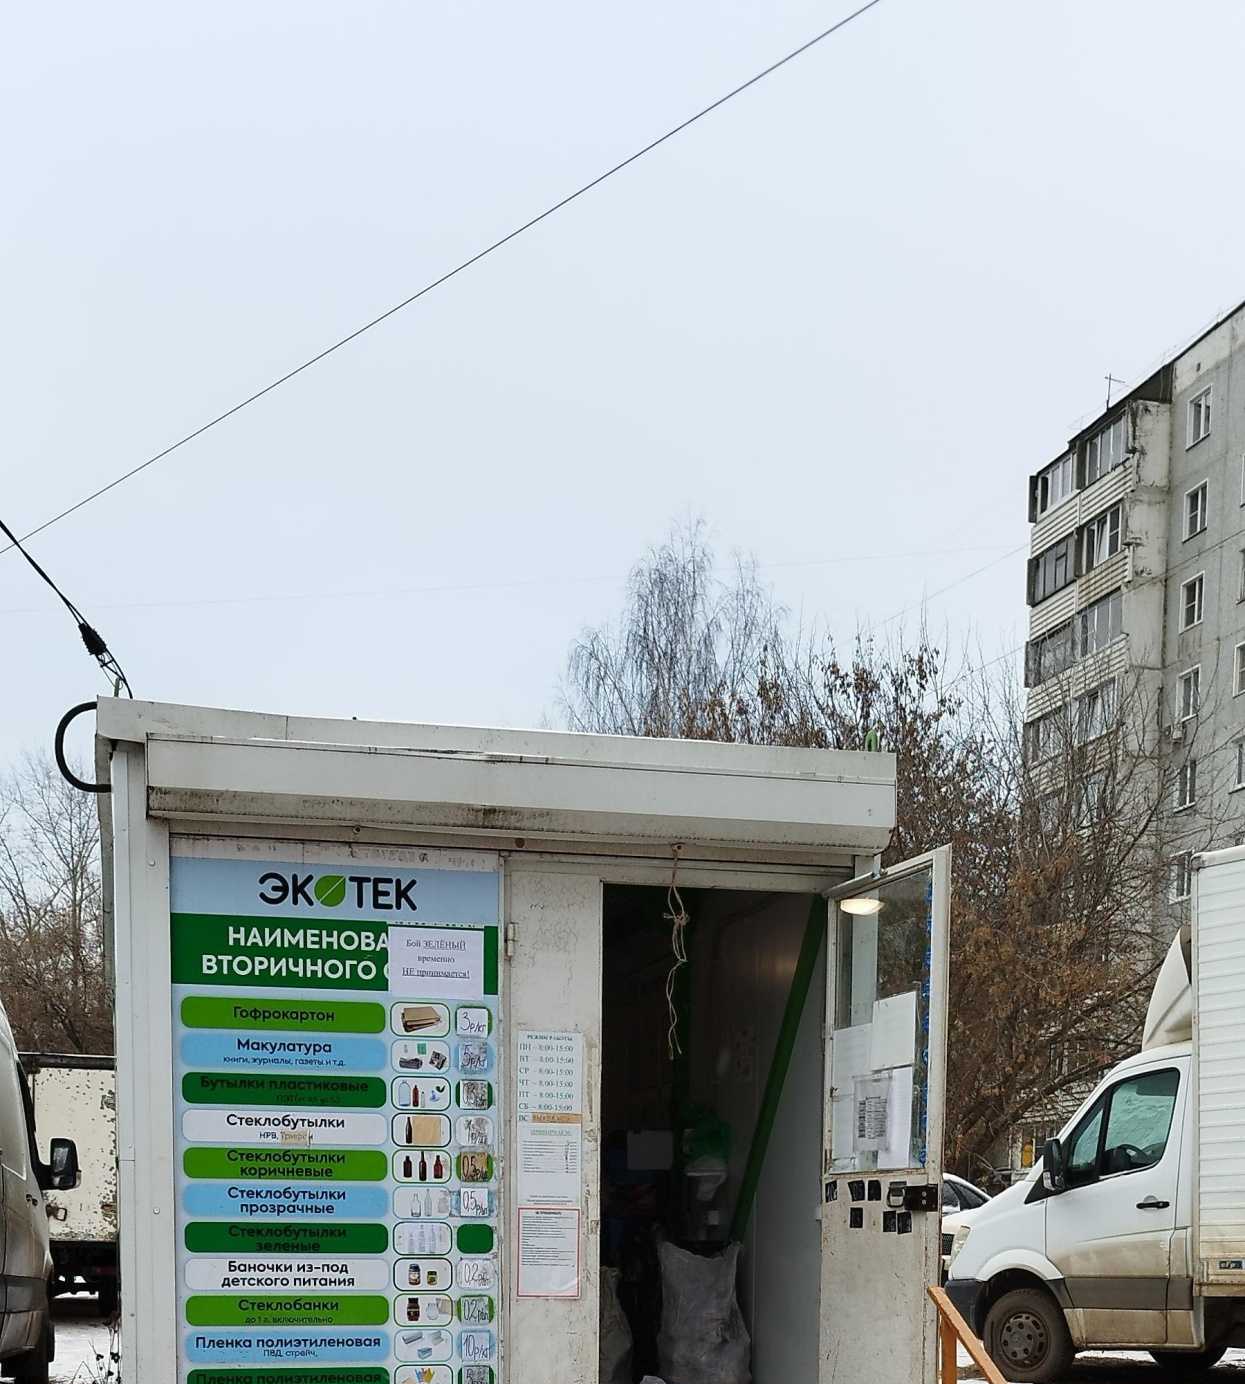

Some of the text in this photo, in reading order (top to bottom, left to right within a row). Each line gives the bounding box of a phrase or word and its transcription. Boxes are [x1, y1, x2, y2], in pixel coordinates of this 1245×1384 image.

[258, 872, 418, 911] ЭКОТЕК
[406, 939, 421, 947] Бой
[417, 955, 456, 964] временно
[201, 954, 377, 980] ВТОРИЧНОГО
[402, 967, 415, 977] НЕ
[416, 968, 471, 979] принимается!
[232, 1006, 336, 1023] Гофрокартон
[237, 1038, 332, 1055] Макулатура
[223, 1056, 251, 1064] книги,
[251, 1056, 293, 1065] журналы,
[294, 1057, 324, 1066] газеты
[200, 1075, 369, 1093] Бутылки пластиковые
[226, 1114, 345, 1130] Стеклобутылки
[226, 1149, 345, 1166] Стеклобутылки
[240, 1165, 333, 1179] коричневые
[227, 1186, 346, 1202] Стеклобутылки
[240, 1203, 335, 1216] прозрачные
[228, 1224, 346, 1241] Стеклобутылки
[255, 1241, 321, 1252] зеленые
[228, 1260, 349, 1275] Баночки из-под
[221, 1276, 355, 1288] детского питания
[238, 1298, 339, 1312] Стеклобанки
[245, 1316, 256, 1324] до
[272, 1316, 334, 1324] включительно
[195, 1336, 381, 1349] Пленка полиэтиленовая
[196, 1373, 382, 1384] Пленка полиэтиленовая
